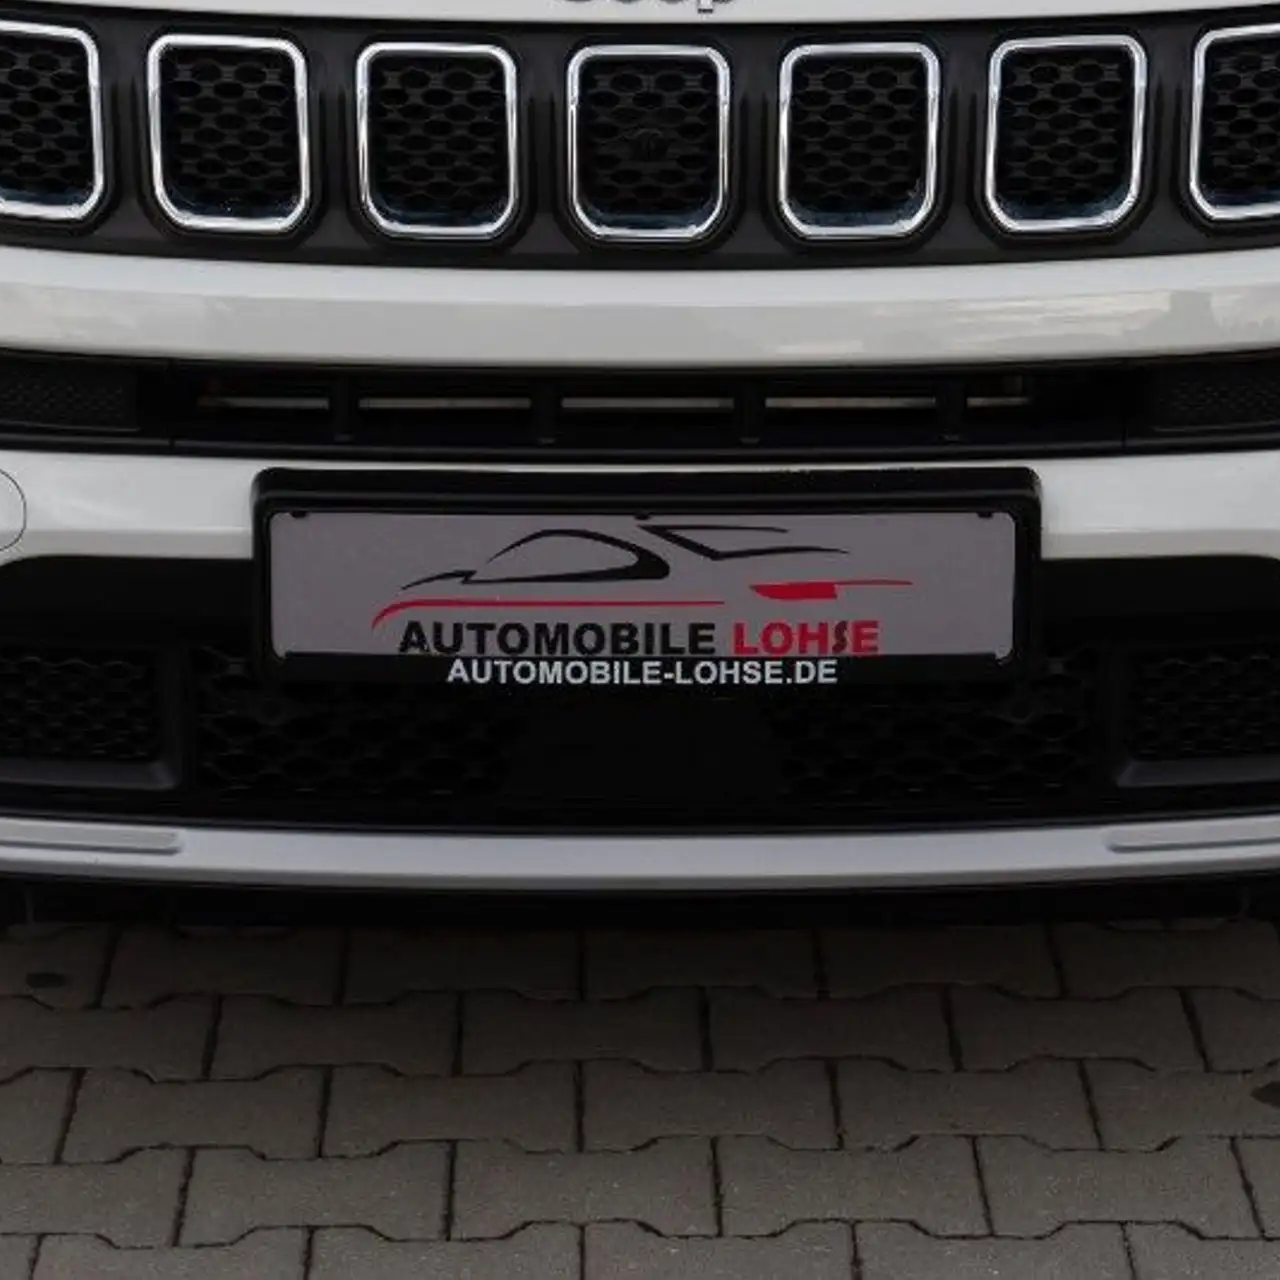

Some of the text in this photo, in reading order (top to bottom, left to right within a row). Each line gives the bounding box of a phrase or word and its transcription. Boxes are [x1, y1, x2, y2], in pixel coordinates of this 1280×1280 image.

[400, 621, 880, 655] AUTOMOBILE LOHSE
[446, 658, 839, 685] AUTOMOBILE-LOHSE.DE
